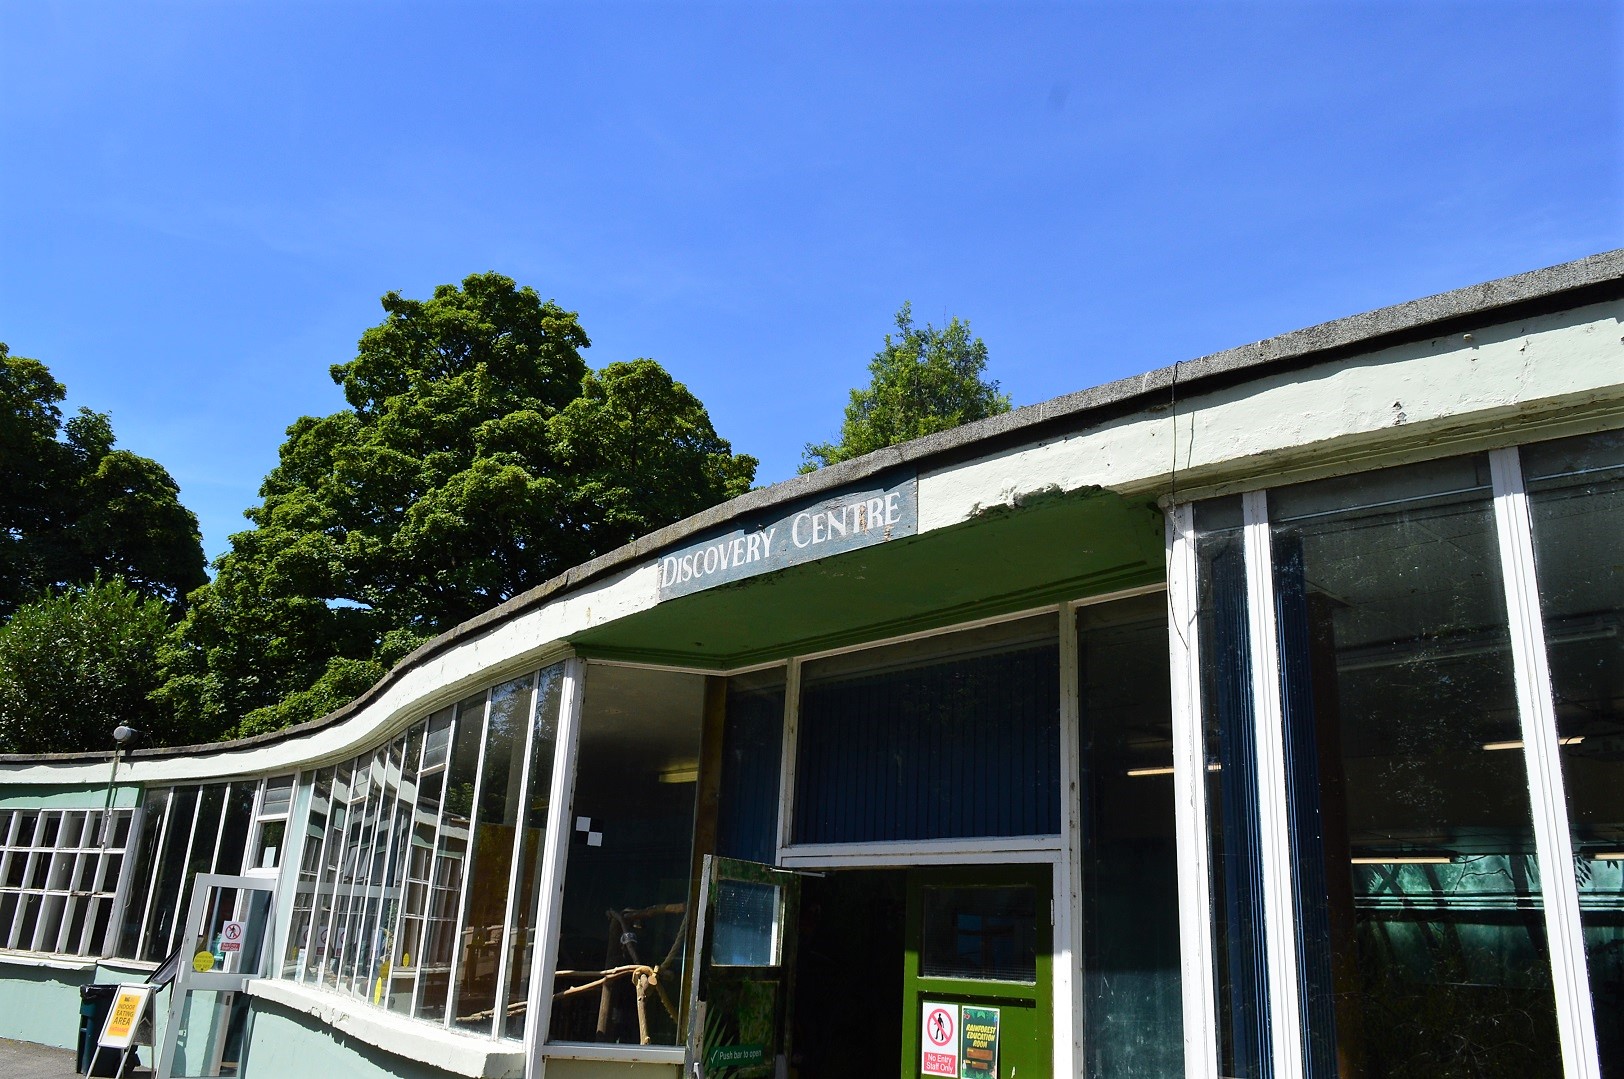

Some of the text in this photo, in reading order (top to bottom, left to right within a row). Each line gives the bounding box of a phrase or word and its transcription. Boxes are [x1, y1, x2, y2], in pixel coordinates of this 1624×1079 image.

[791, 491, 902, 549] CENTRE
[112, 1017, 131, 1026] AREA
[966, 1024, 996, 1034] RAINFOREST
[966, 1032, 996, 1041] EDUCATION
[972, 1040, 988, 1048] ROOM
[720, 1051, 733, 1060] Push
[733, 1051, 742, 1059] bar
[750, 1050, 762, 1059] open
[927, 1053, 953, 1064] No Entry
[926, 1061, 954, 1073] Staff Only
